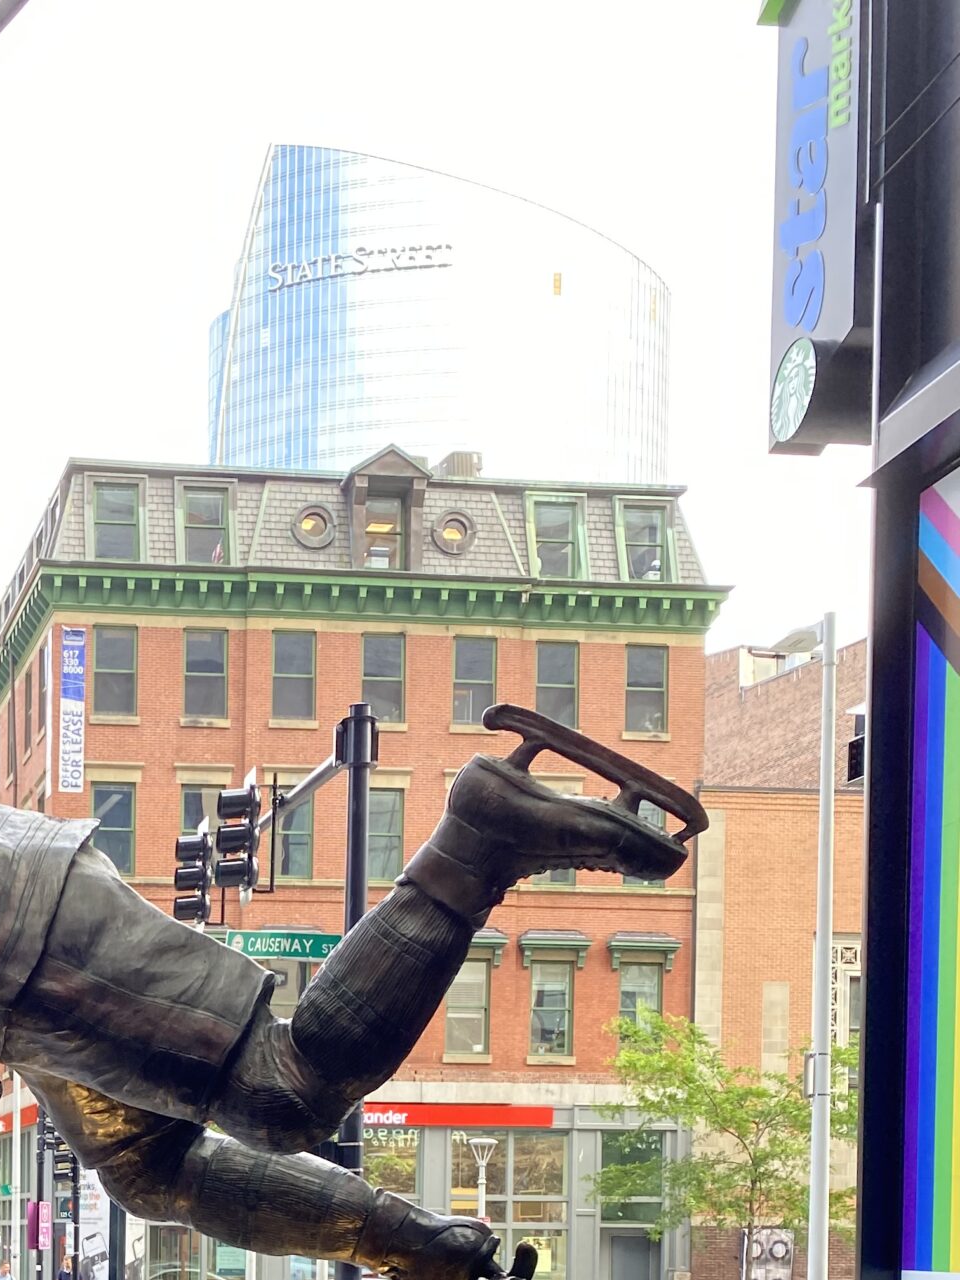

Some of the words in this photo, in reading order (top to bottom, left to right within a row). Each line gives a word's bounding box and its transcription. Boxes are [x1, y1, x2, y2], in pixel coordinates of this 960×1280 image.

[827, 0, 852, 129] mark
[779, 37, 830, 333] star
[268, 254, 344, 292] STATE
[352, 244, 453, 276] STREET
[63, 650, 79, 658] 617
[63, 658, 79, 666] 330
[63, 666, 84, 674] 8000
[62, 710, 72, 745] SPACE
[71, 710, 83, 753] LEASE
[61, 749, 71, 788] OFFICE
[70, 760, 82, 788] FOR
[247, 937, 314, 953] CAUSEWAY
[322, 944, 334, 954] ST
[363, 1109, 408, 1124] ander
